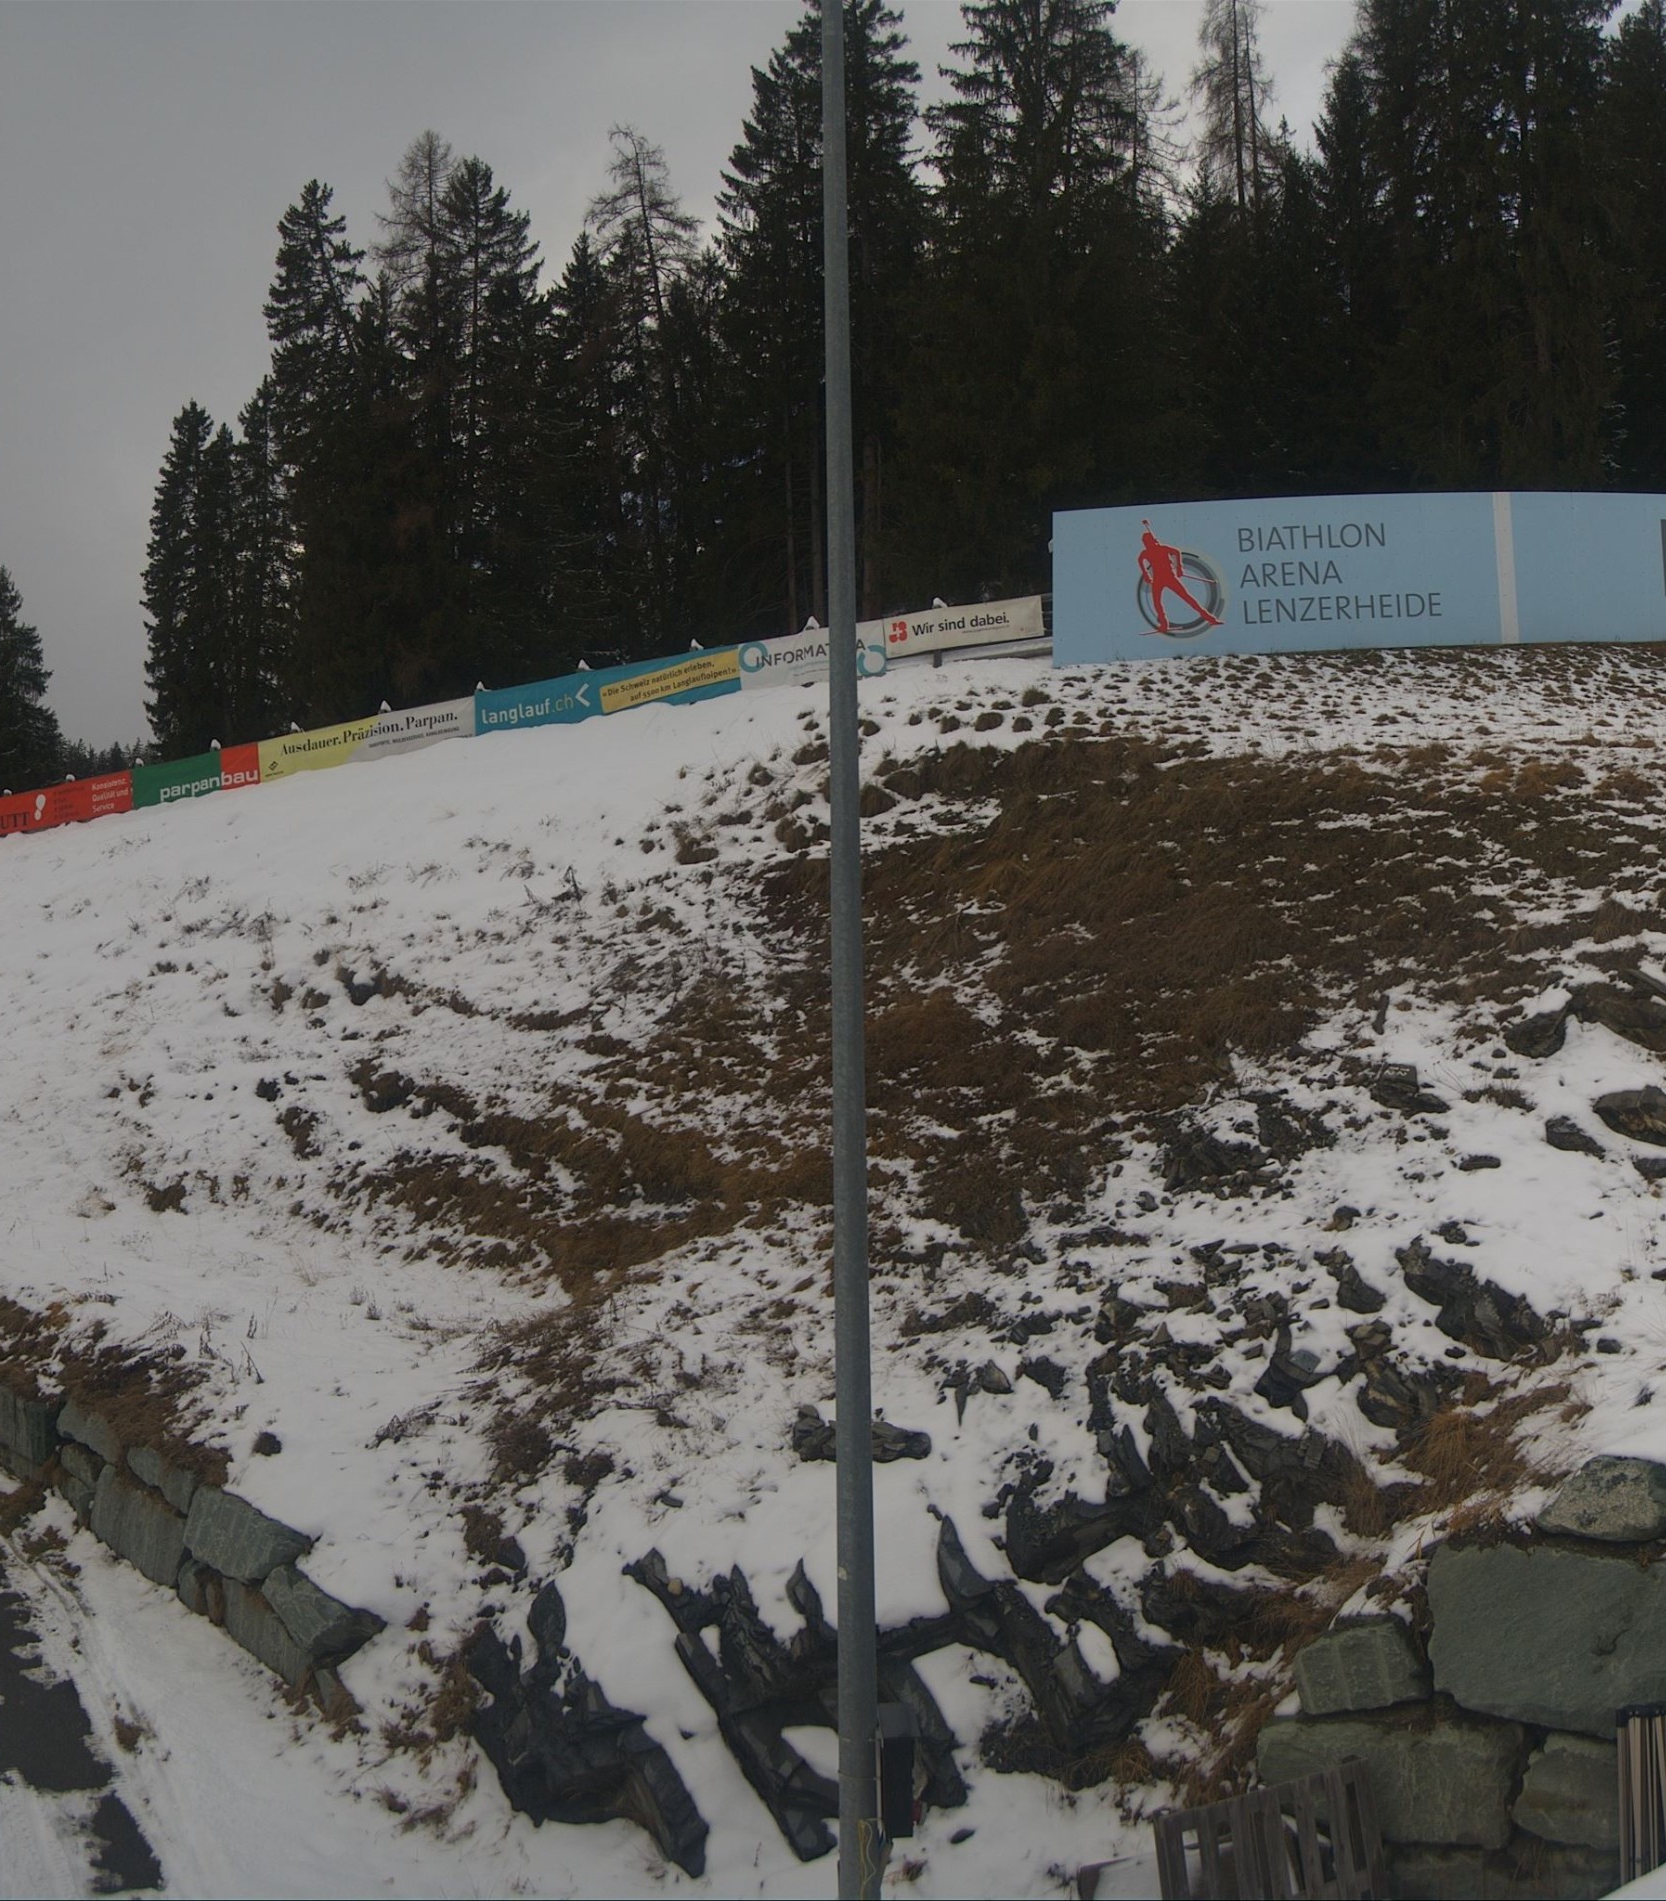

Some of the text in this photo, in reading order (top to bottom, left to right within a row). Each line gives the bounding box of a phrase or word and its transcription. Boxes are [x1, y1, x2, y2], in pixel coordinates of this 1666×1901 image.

[1237, 522, 1387, 552] BIATHLON
[1239, 560, 1343, 589] ARENA
[1243, 592, 1443, 625] LENZERHEIDE
[912, 622, 935, 636] Wir
[938, 617, 965, 632] sind
[970, 612, 1010, 627] dabei.
[620, 680, 650, 693] Schweiz
[630, 692, 641, 702] auf
[660, 684, 671, 693] km
[405, 712, 458, 729] Parpan.
[481, 693, 574, 724] langlauf.ch
[160, 769, 259, 802] parpanbau
[92, 802, 115, 813] Service
